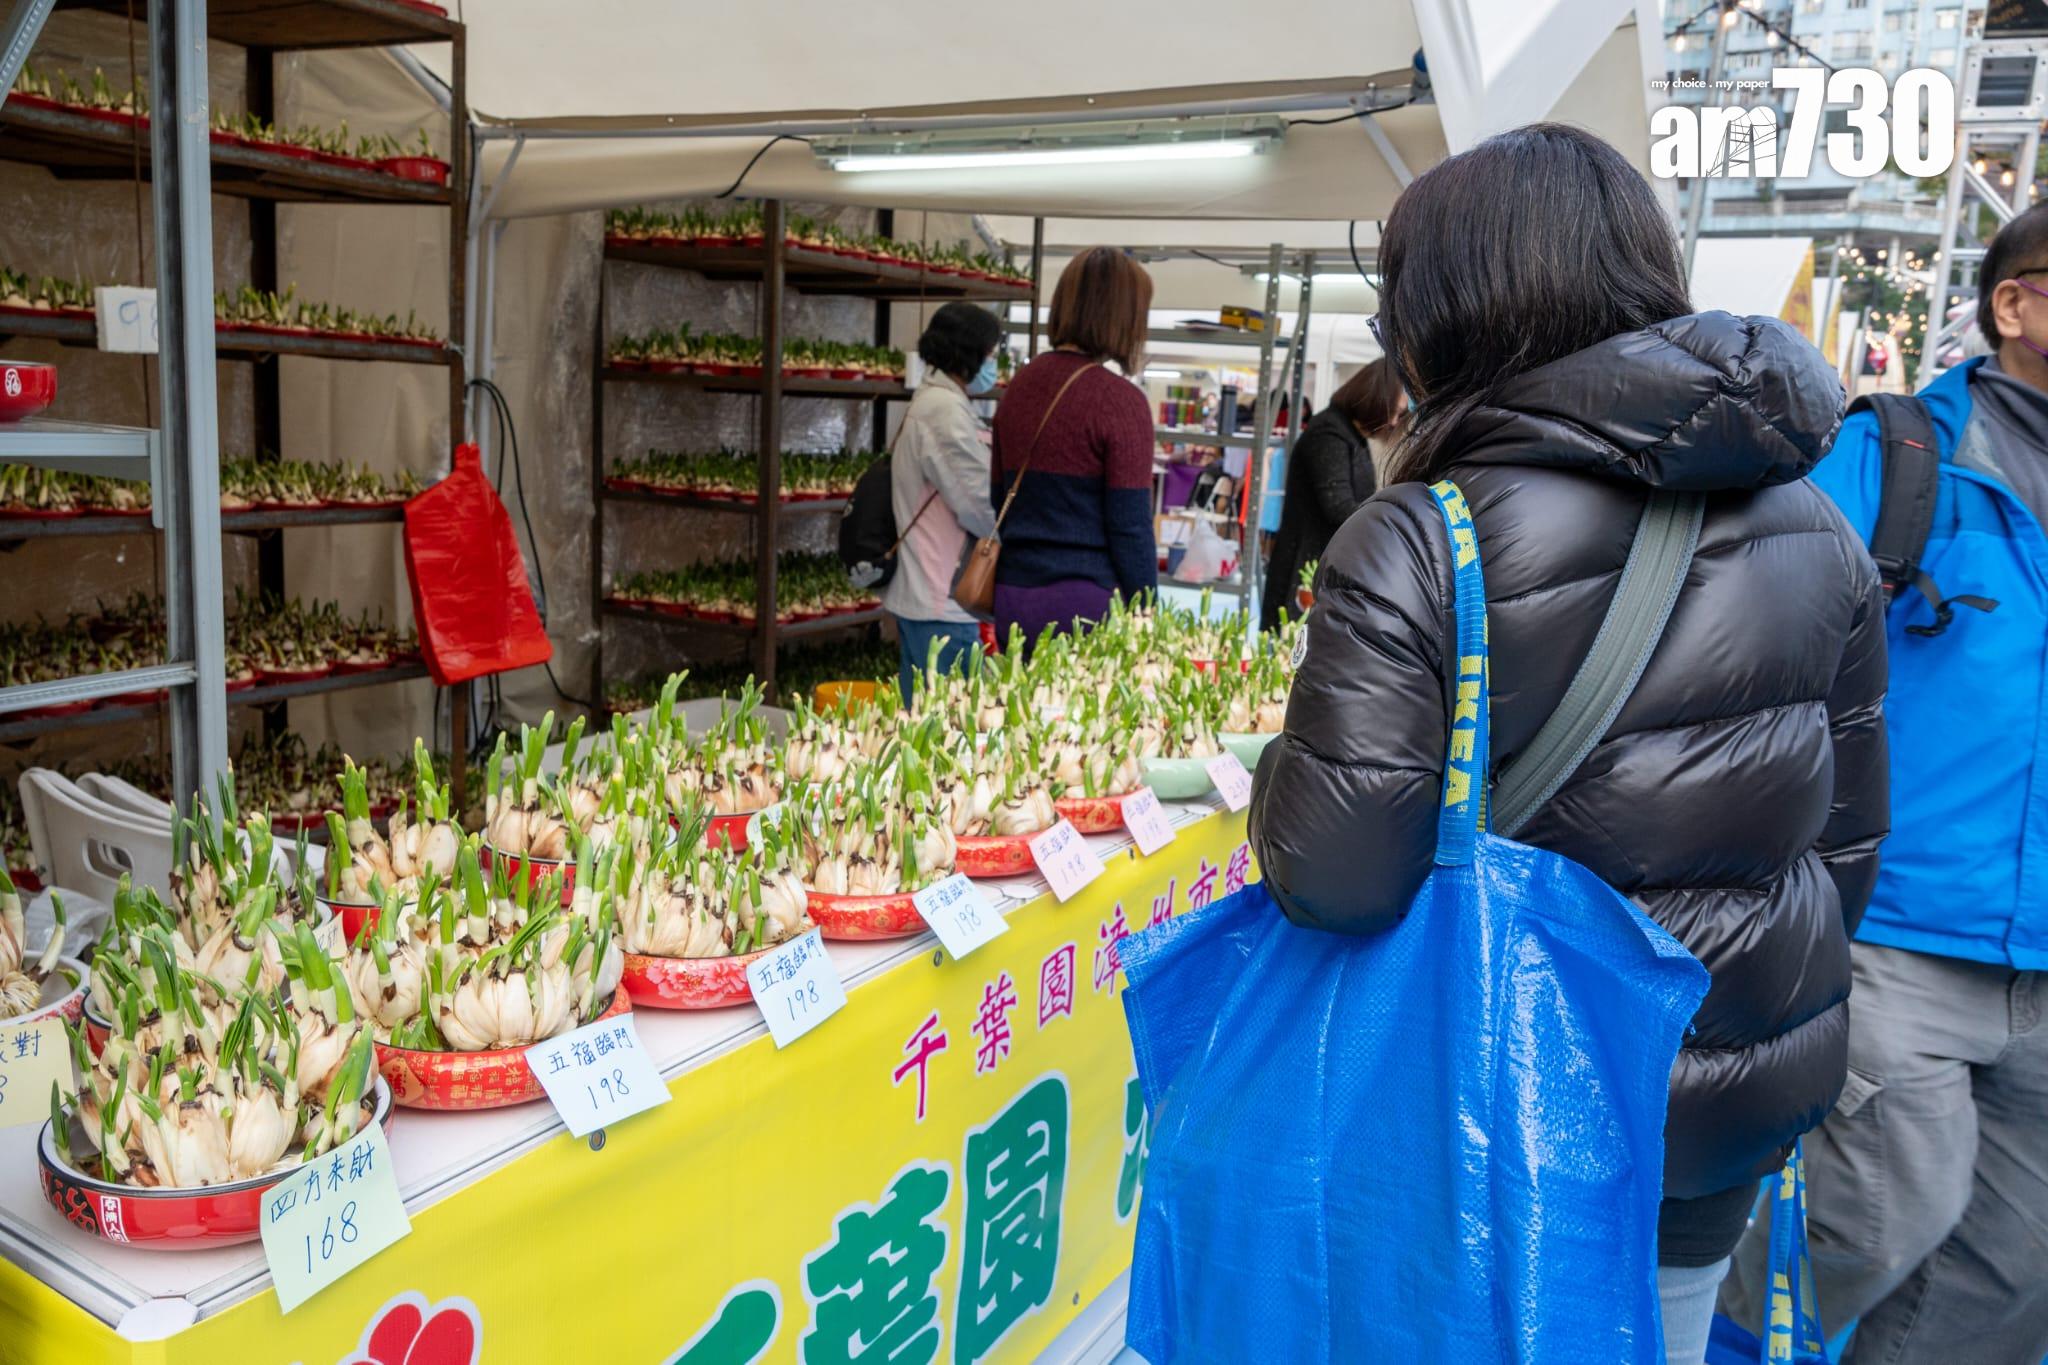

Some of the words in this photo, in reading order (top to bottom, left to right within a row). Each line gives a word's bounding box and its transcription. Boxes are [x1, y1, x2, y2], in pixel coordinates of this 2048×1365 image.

[1059, 855, 1086, 884] 198
[954, 903, 982, 937] 198
[759, 936, 823, 994] 五福臨門
[786, 979, 821, 1022] 198
[548, 1026, 633, 1075] 五福臨門
[587, 1068, 631, 1111] 198
[305, 1201, 359, 1274] 168
[1769, 1272, 1792, 1365] IKE
